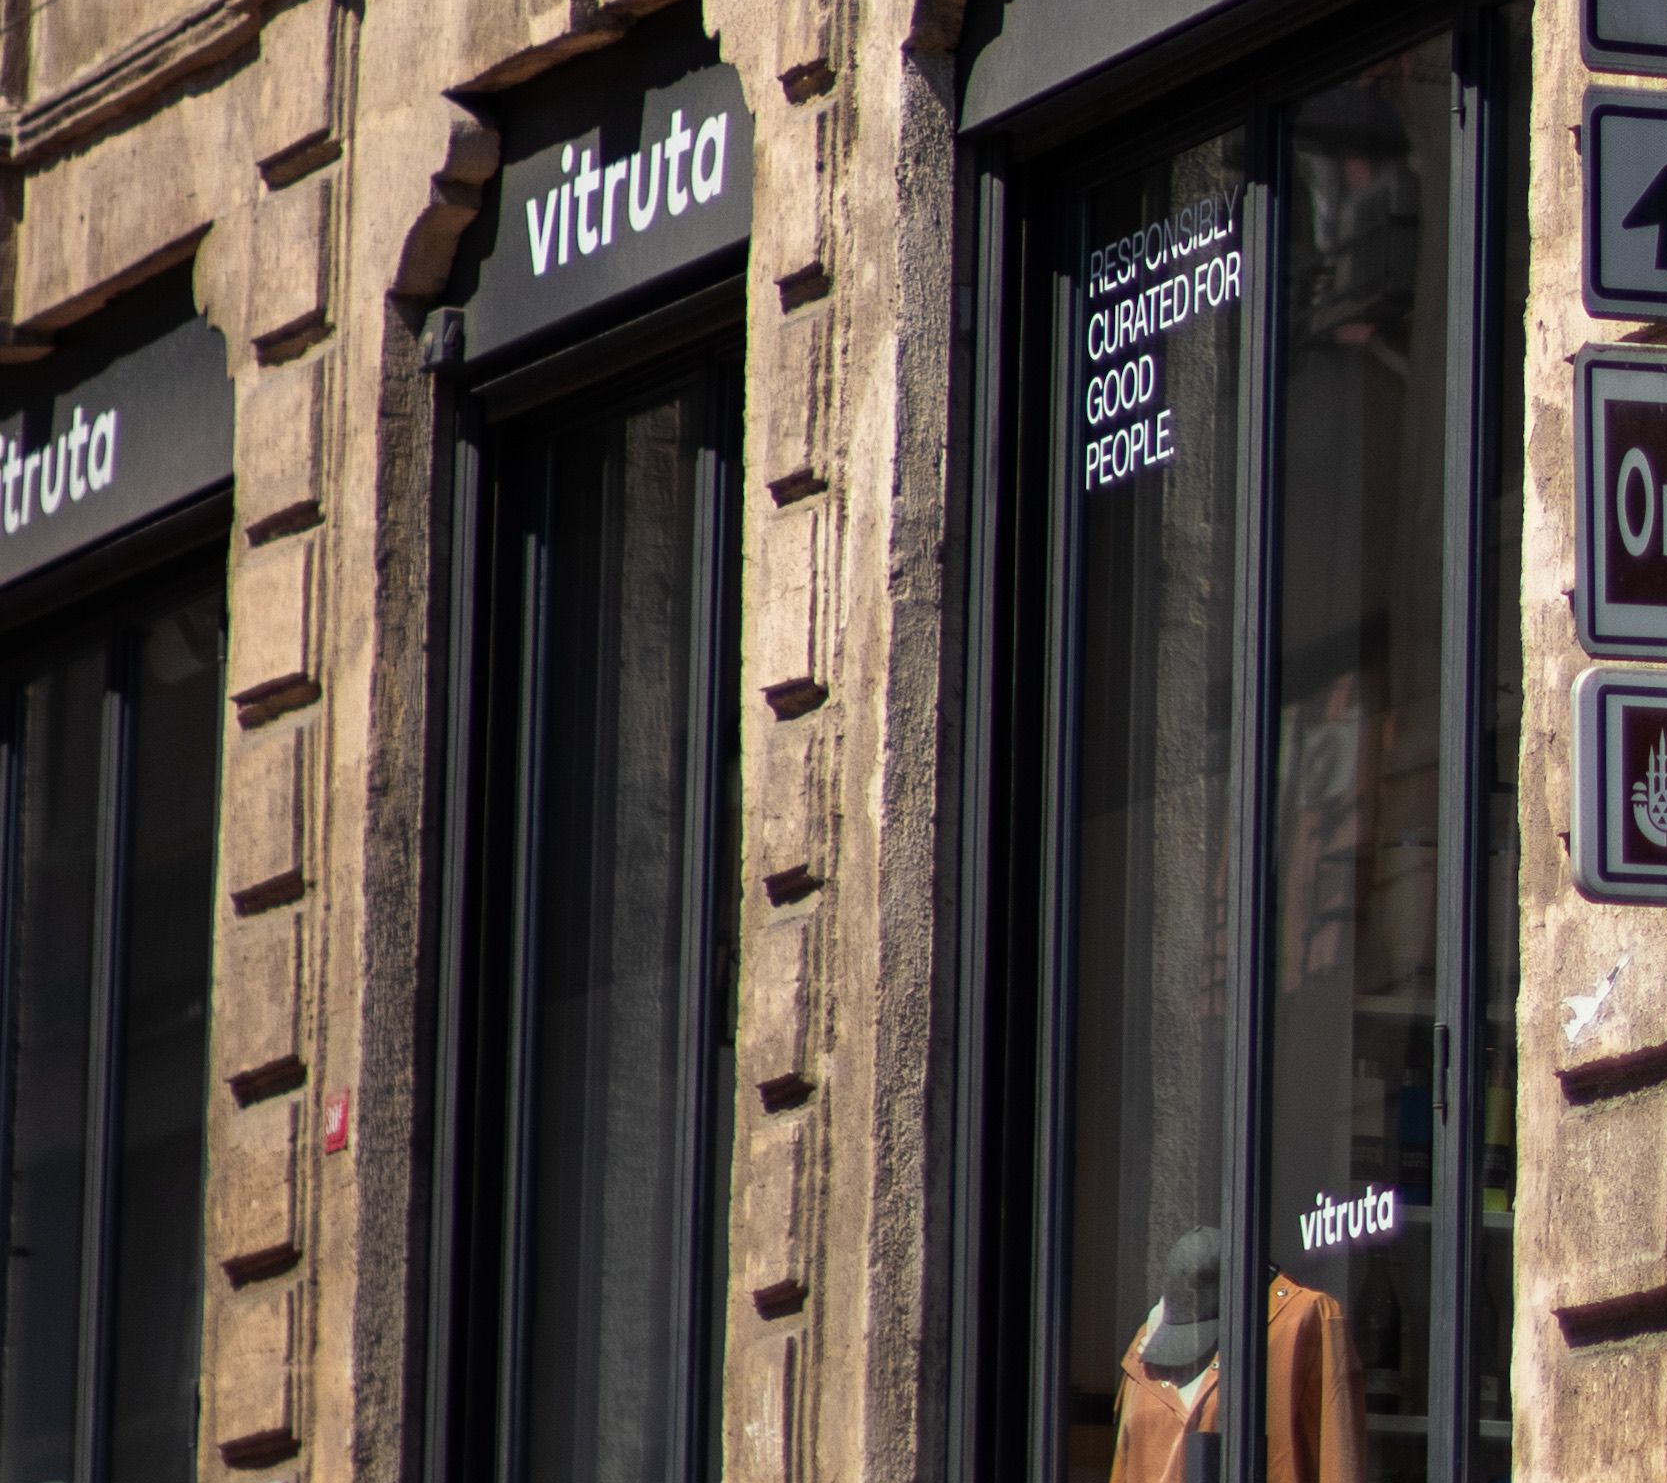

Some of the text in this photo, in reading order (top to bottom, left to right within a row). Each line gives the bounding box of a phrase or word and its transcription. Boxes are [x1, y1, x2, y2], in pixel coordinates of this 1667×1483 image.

[526, 108, 729, 276] vitruta
[1090, 184, 1239, 299] RESPONSIBLY
[1088, 251, 1241, 361] CURATED FOR
[1086, 354, 1154, 426] GOOD
[0, 404, 118, 534] truta
[1086, 409, 1175, 491] PEOPLE.
[1299, 1185, 1395, 1250] vitruta
